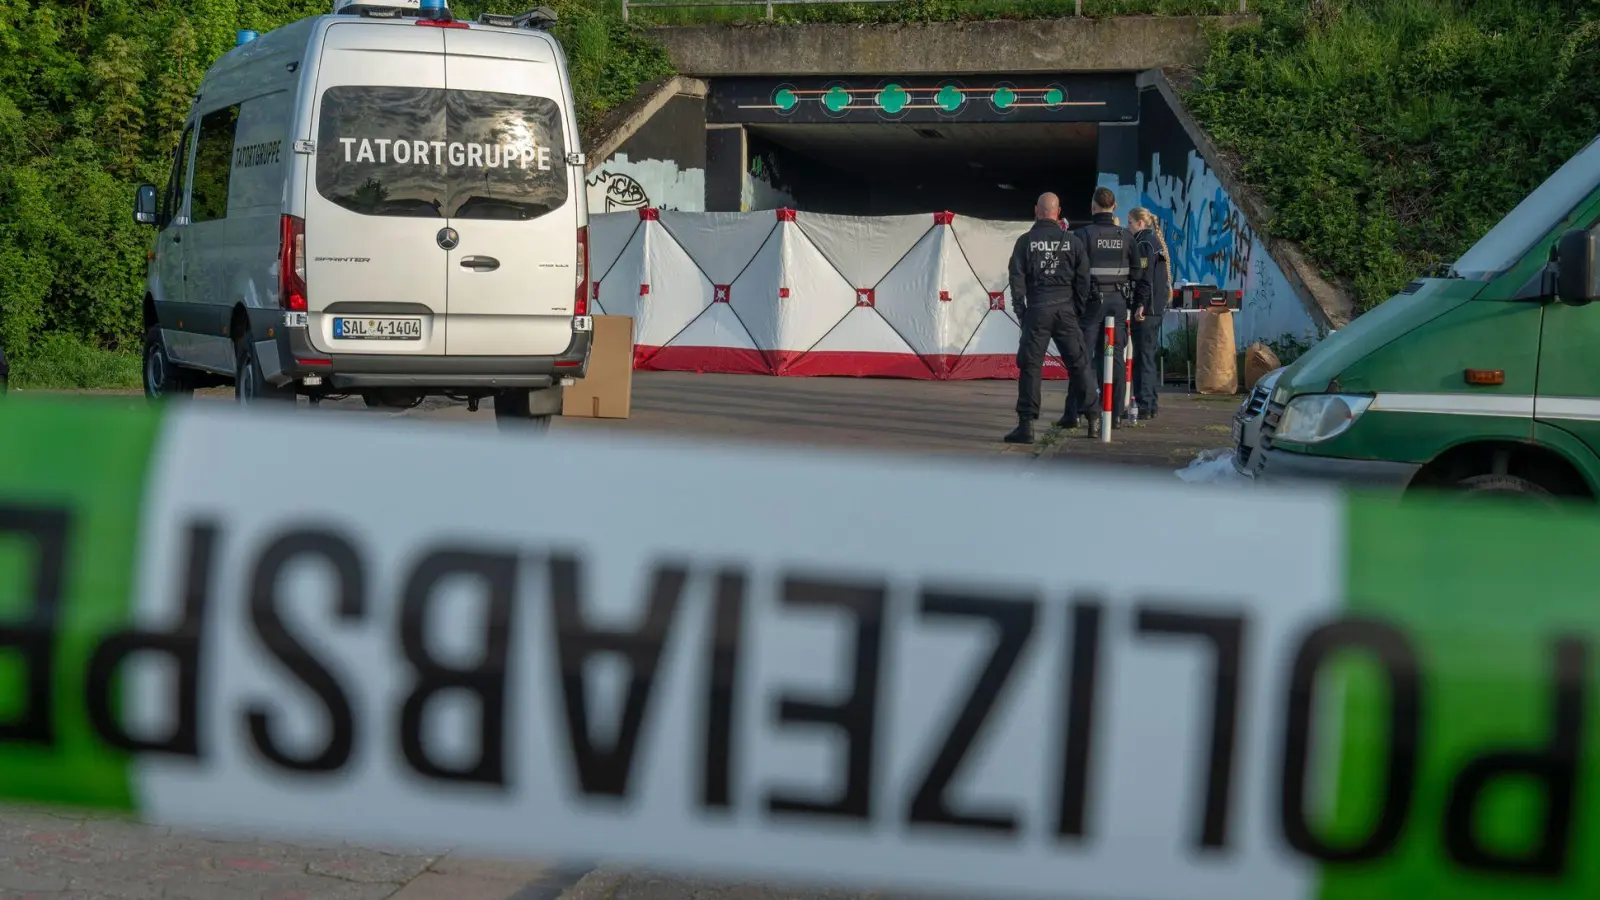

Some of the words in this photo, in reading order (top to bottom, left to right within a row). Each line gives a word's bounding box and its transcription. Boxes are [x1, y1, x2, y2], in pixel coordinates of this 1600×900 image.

[236, 140, 281, 168] TATORTGRUPPE
[339, 137, 550, 171] TATORTGRUPPE
[1030, 240, 1071, 252] POLIZEI
[1097, 239, 1123, 249] POLIZEI
[343, 320, 367, 334] SAL
[376, 321, 419, 335] 4-1404
